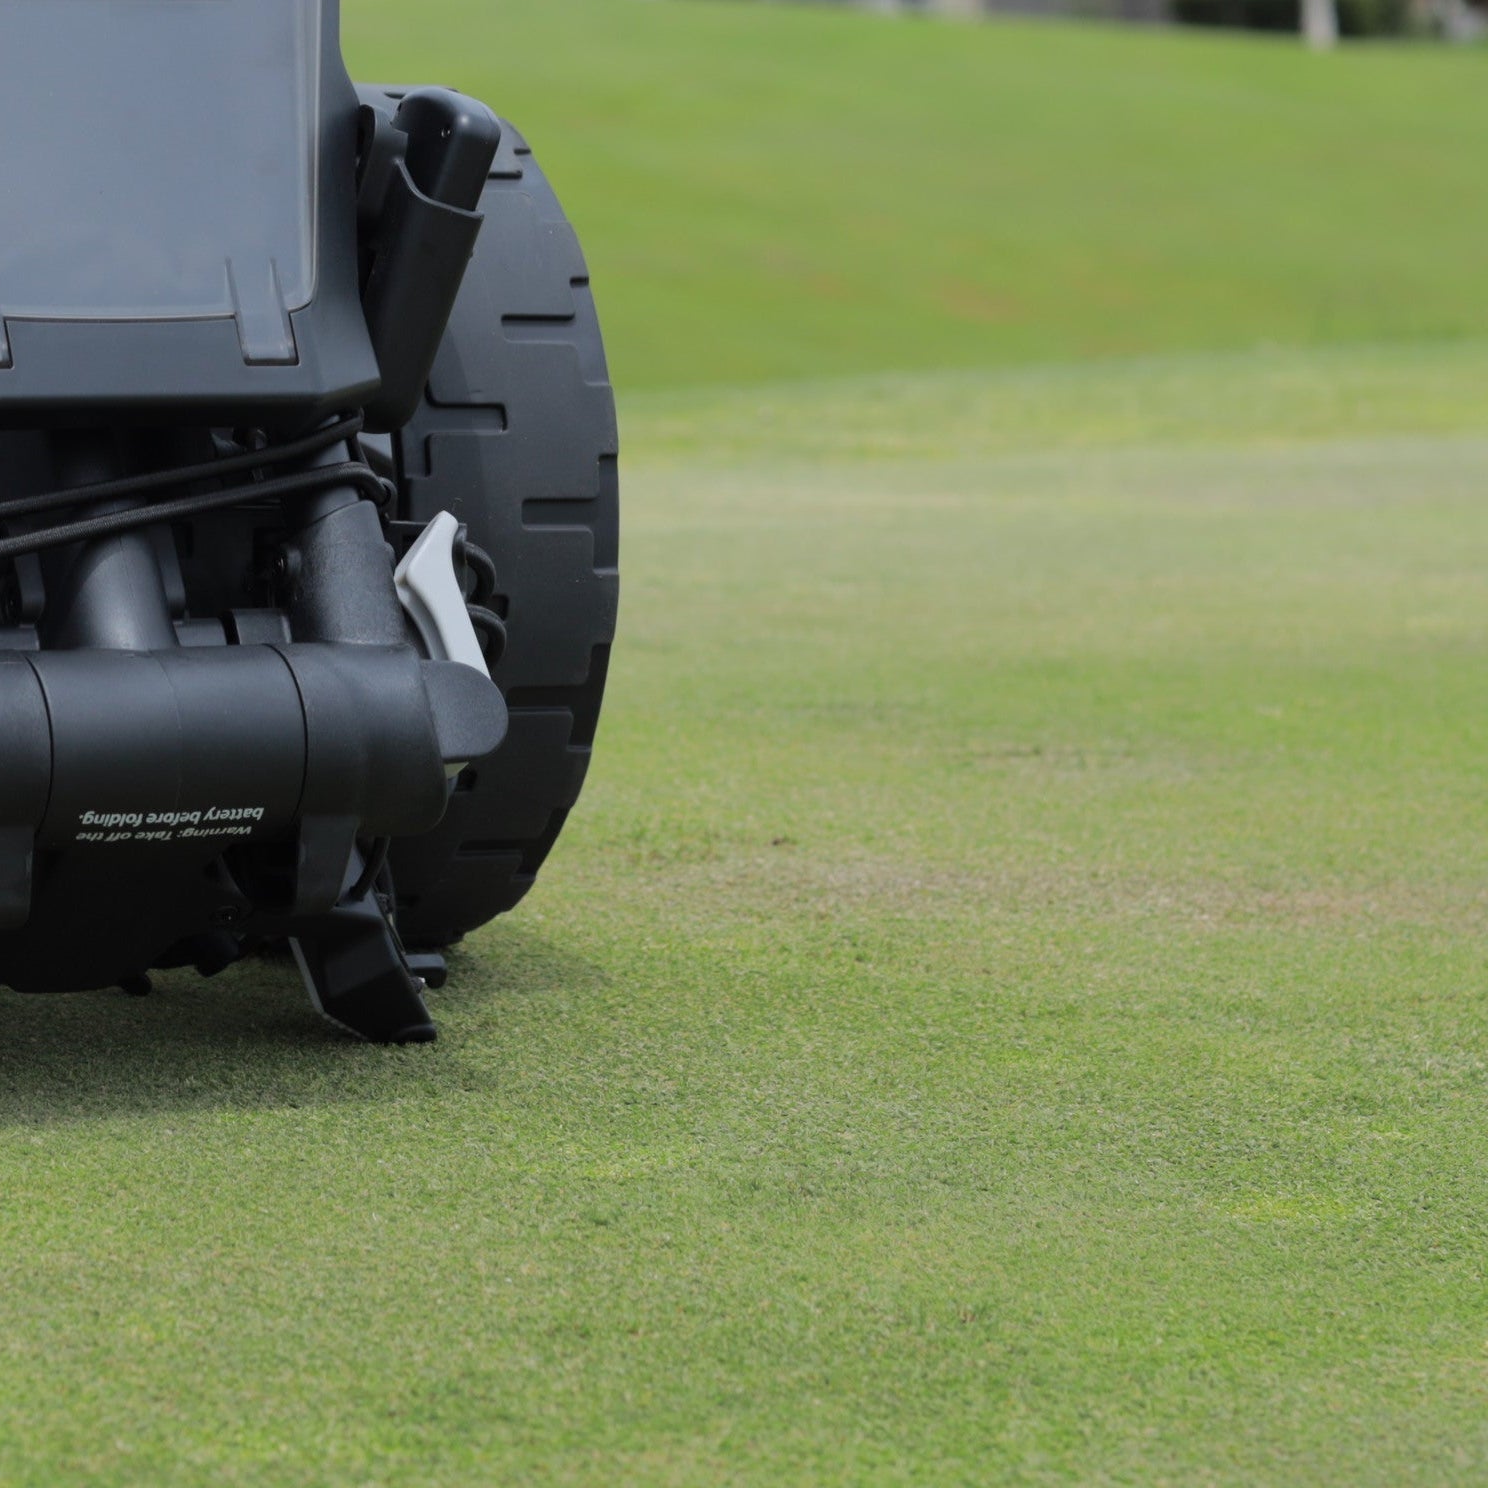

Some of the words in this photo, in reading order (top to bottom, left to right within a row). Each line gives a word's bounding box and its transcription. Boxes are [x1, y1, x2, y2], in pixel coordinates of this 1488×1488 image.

[78, 809, 143, 828] folding.
[145, 810, 201, 827] before
[204, 806, 265, 821] battery
[76, 830, 104, 842] the
[104, 830, 132, 842] off
[134, 830, 173, 841] Take
[177, 825, 252, 838] Warning:
